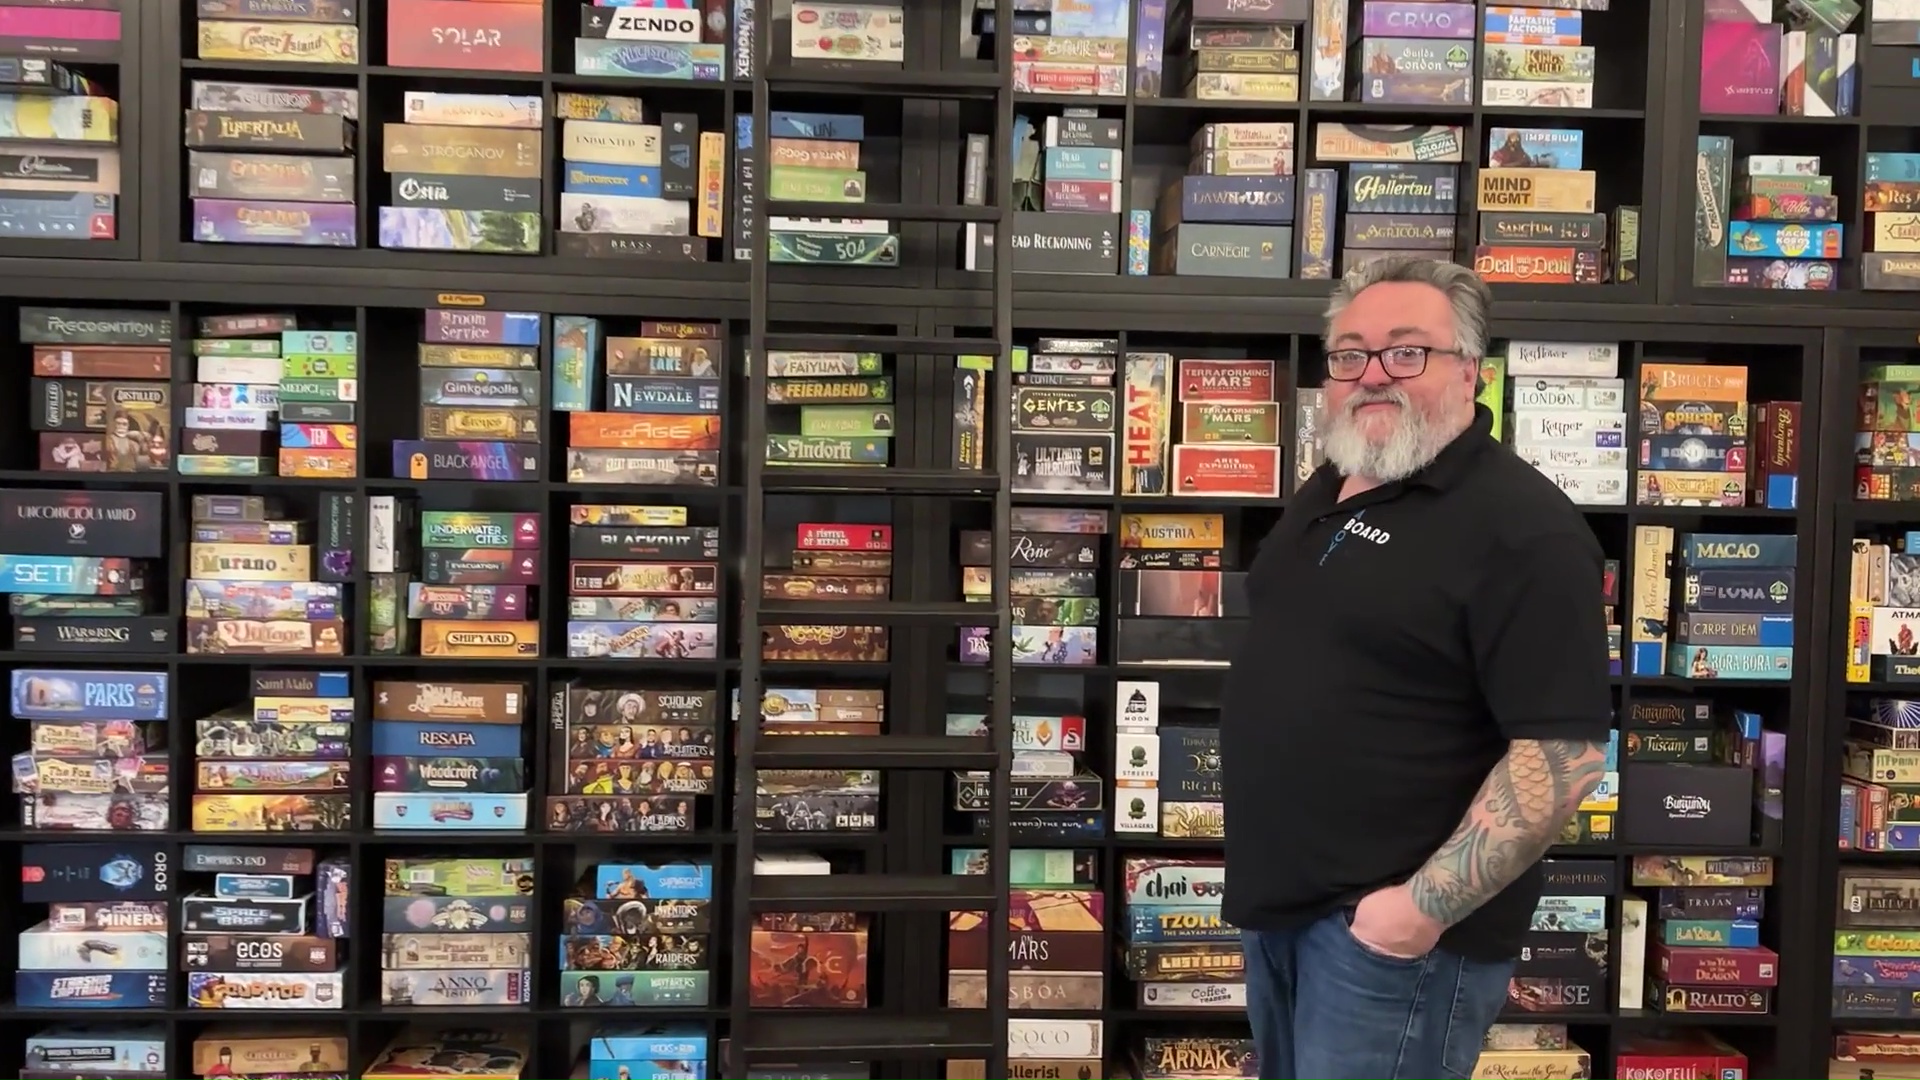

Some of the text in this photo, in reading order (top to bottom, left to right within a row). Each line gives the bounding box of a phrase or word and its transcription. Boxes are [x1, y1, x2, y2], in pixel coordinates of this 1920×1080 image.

[619, 17, 694, 33] ZENDO
[1387, 12, 1451, 28] CRYO
[1508, 15, 1556, 26] FANTASTIC
[431, 27, 501, 47] SOLAR
[1508, 25, 1556, 35] FACTORIES
[1395, 57, 1442, 71] London
[218, 116, 304, 140] LIBERTALIA
[1525, 133, 1578, 143] IMPERIUM
[422, 145, 504, 160] STROGANOV
[1355, 176, 1433, 200] Hallertau
[1484, 178, 1532, 191] MIND
[1484, 193, 1531, 205] MGMT
[1699, 168, 1720, 231] EMBARCADERO
[1366, 225, 1434, 239] AGRICOLA
[1498, 221, 1553, 237] SANCTUM
[1012, 233, 1092, 250] EAD RECKONING
[835, 240, 866, 259] 504
[1191, 243, 1250, 259] CARNEGIE
[1477, 255, 1571, 275] Deal Devil
[48, 317, 153, 336] PRECOGNITION
[440, 313, 485, 325] Broom
[441, 326, 489, 340] Service
[1185, 369, 1270, 378] TERRAFORMING
[1662, 370, 1721, 388] BRUGES
[280, 383, 319, 393] MEDICI
[445, 382, 519, 397] Ginkgopolis
[1202, 376, 1252, 388] MARS
[614, 383, 694, 406] NEWDALE
[787, 383, 868, 398] FEIERABEND
[1023, 398, 1086, 413] GENTES
[1522, 392, 1580, 406] LONDON
[1199, 407, 1265, 415] TERRAFORMING
[1212, 412, 1252, 423] MARS
[1128, 384, 1151, 466] HEAT
[1773, 408, 1790, 467] Burgundy
[434, 454, 508, 469] BLACK ANGEL
[430, 525, 501, 536] UNDERWATER
[1143, 527, 1196, 540] AUSTRIA
[1343, 517, 1391, 545] BOARD
[476, 534, 508, 545] CITIES
[1698, 543, 1760, 558] MACAO
[201, 555, 277, 573] Murano
[451, 562, 500, 570] EVACUATION
[14, 564, 73, 583] SETI
[1719, 587, 1766, 599] LUNA
[1694, 623, 1757, 636] CARPE DIEM
[451, 633, 510, 644] SHIPYARD
[1742, 656, 1771, 671] BORA
[85, 682, 135, 707] PARIS
[420, 731, 475, 746] RESAFA
[1644, 736, 1688, 757] Tuscany
[50, 766, 91, 778] The Fox
[420, 764, 478, 779] Woodcraft
[42, 775, 108, 789] Experiment
[244, 855, 266, 867] END
[154, 852, 167, 892] OROS
[1146, 873, 1187, 899] chai
[1688, 898, 1733, 908] TRAJAN
[98, 912, 163, 927] MINERS
[236, 942, 282, 959] ecos
[656, 953, 696, 965] RAIDERS
[434, 976, 488, 989] ANNO
[1009, 986, 1066, 999] SBOA
[1191, 985, 1227, 999] Coffee
[1691, 992, 1746, 1007] RIALTO
[1158, 1047, 1233, 1070] ARNAK
[1008, 1066, 1060, 1079] allerist
